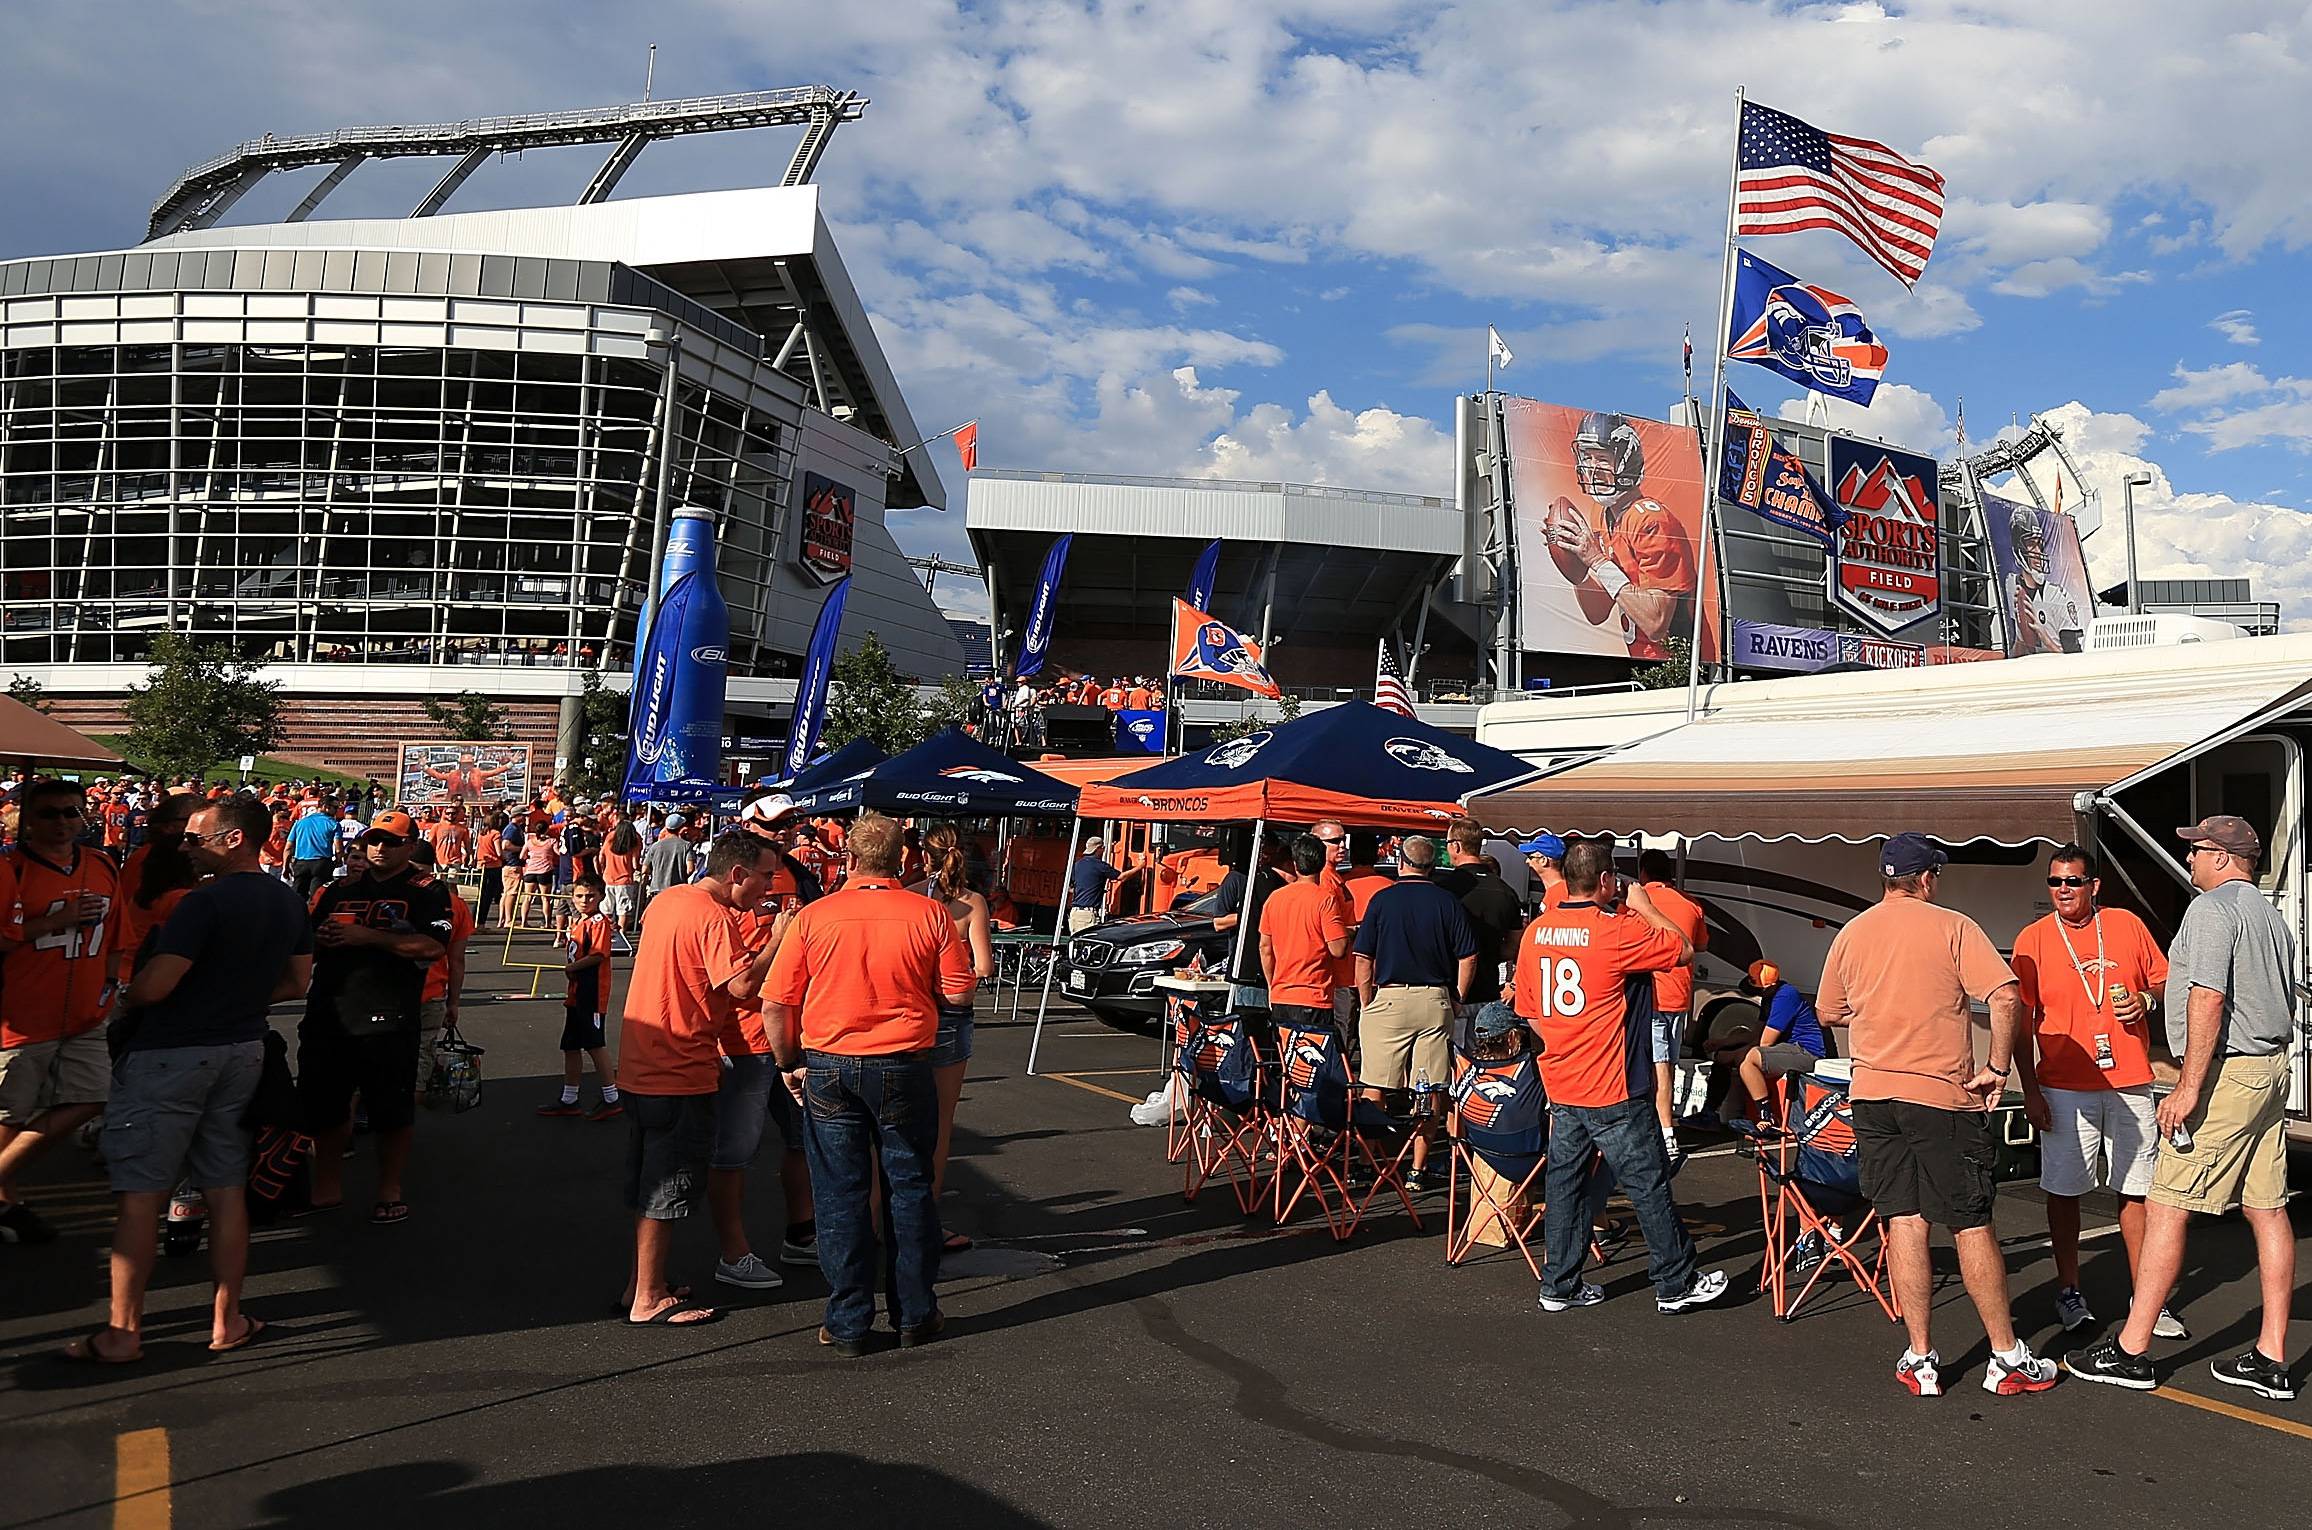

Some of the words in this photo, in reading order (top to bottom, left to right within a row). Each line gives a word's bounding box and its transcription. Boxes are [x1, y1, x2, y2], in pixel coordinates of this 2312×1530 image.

[1742, 428, 1764, 502] BRONCOS
[1776, 472, 1804, 490] Sup
[810, 513, 853, 538] SPORTS
[1841, 511, 1937, 552] SPORTS
[820, 549, 840, 561] FIELD
[1843, 540, 1935, 571] AUTHORITY
[1870, 571, 1912, 588] FIELD
[1029, 622, 1042, 650] BUD
[1036, 581, 1051, 624] LIGHT
[700, 649, 728, 662] BL
[1750, 633, 1829, 661] RAVENS
[1865, 644, 1916, 669] KICKOFF
[649, 651, 667, 713] LIGHT
[1110, 693, 1119, 703] 18
[642, 712, 657, 757] BUD
[721, 740, 732, 748] 10
[792, 715, 809, 770] BUD
[896, 792, 920, 800] BUD
[924, 793, 956, 802] LIGHT
[1041, 801, 1069, 809] LIGHT
[1152, 797, 1209, 812] BRONCOS
[110, 812, 126, 826] 18
[1534, 927, 1590, 947] MANNING
[1540, 956, 1586, 1017] 18
[1804, 1093, 1842, 1127] BRONCOS
